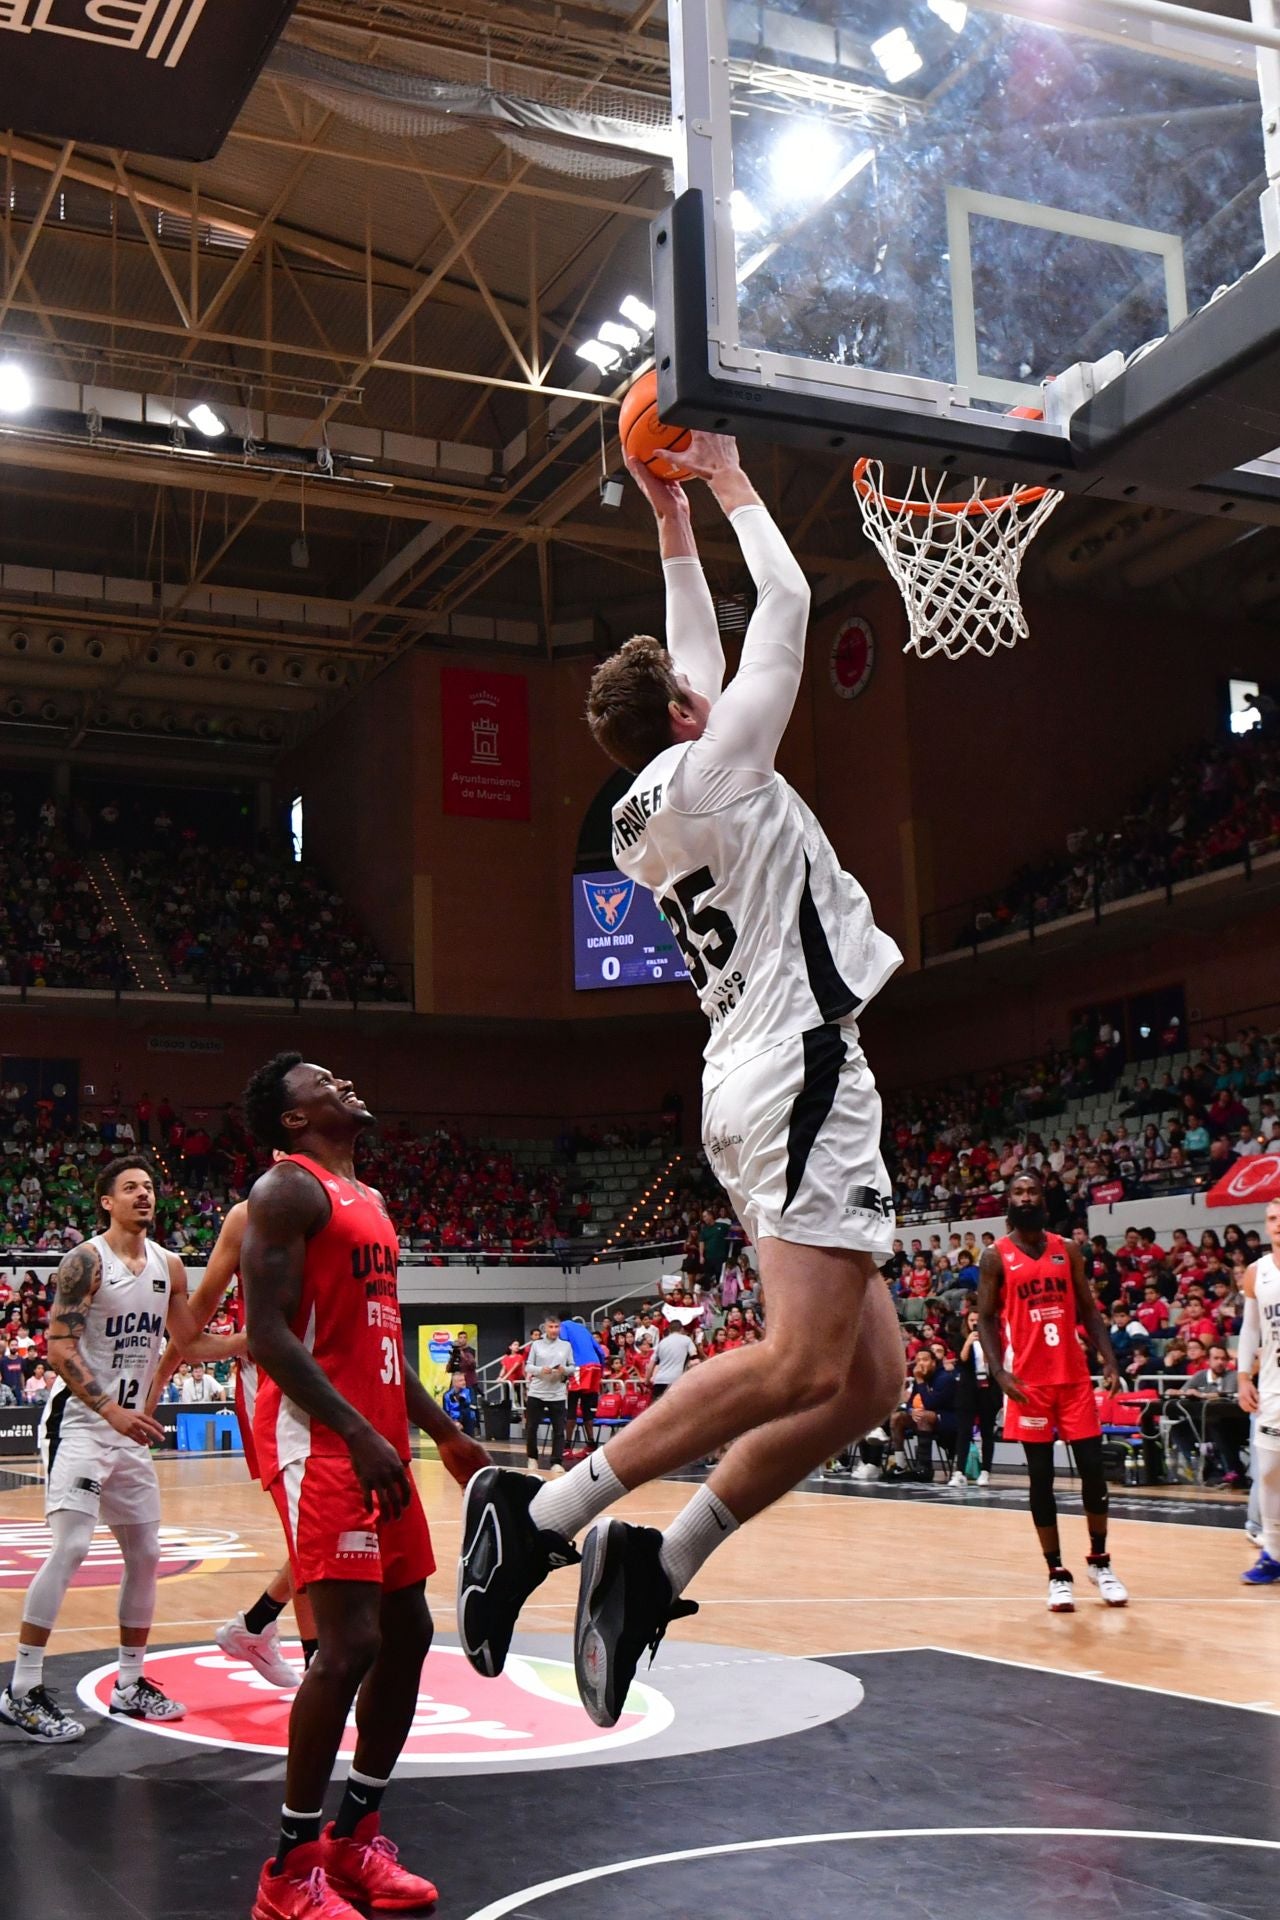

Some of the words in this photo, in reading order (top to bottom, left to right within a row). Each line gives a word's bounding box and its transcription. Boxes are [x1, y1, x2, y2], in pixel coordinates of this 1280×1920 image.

[451, 771, 521, 788] Ayuntamiento
[461, 788, 474, 799] de
[476, 789, 511, 801] Murcia
[587, 936, 611, 948] UCAM
[612, 934, 634, 946] ROJO
[602, 956, 620, 981] 0
[653, 966, 663, 978] 0
[352, 1242, 397, 1279] UCA
[105, 1312, 162, 1338] UCAM
[1043, 1323, 1060, 1347] 8
[380, 1336, 401, 1386] 31
[117, 1378, 140, 1410] 12
